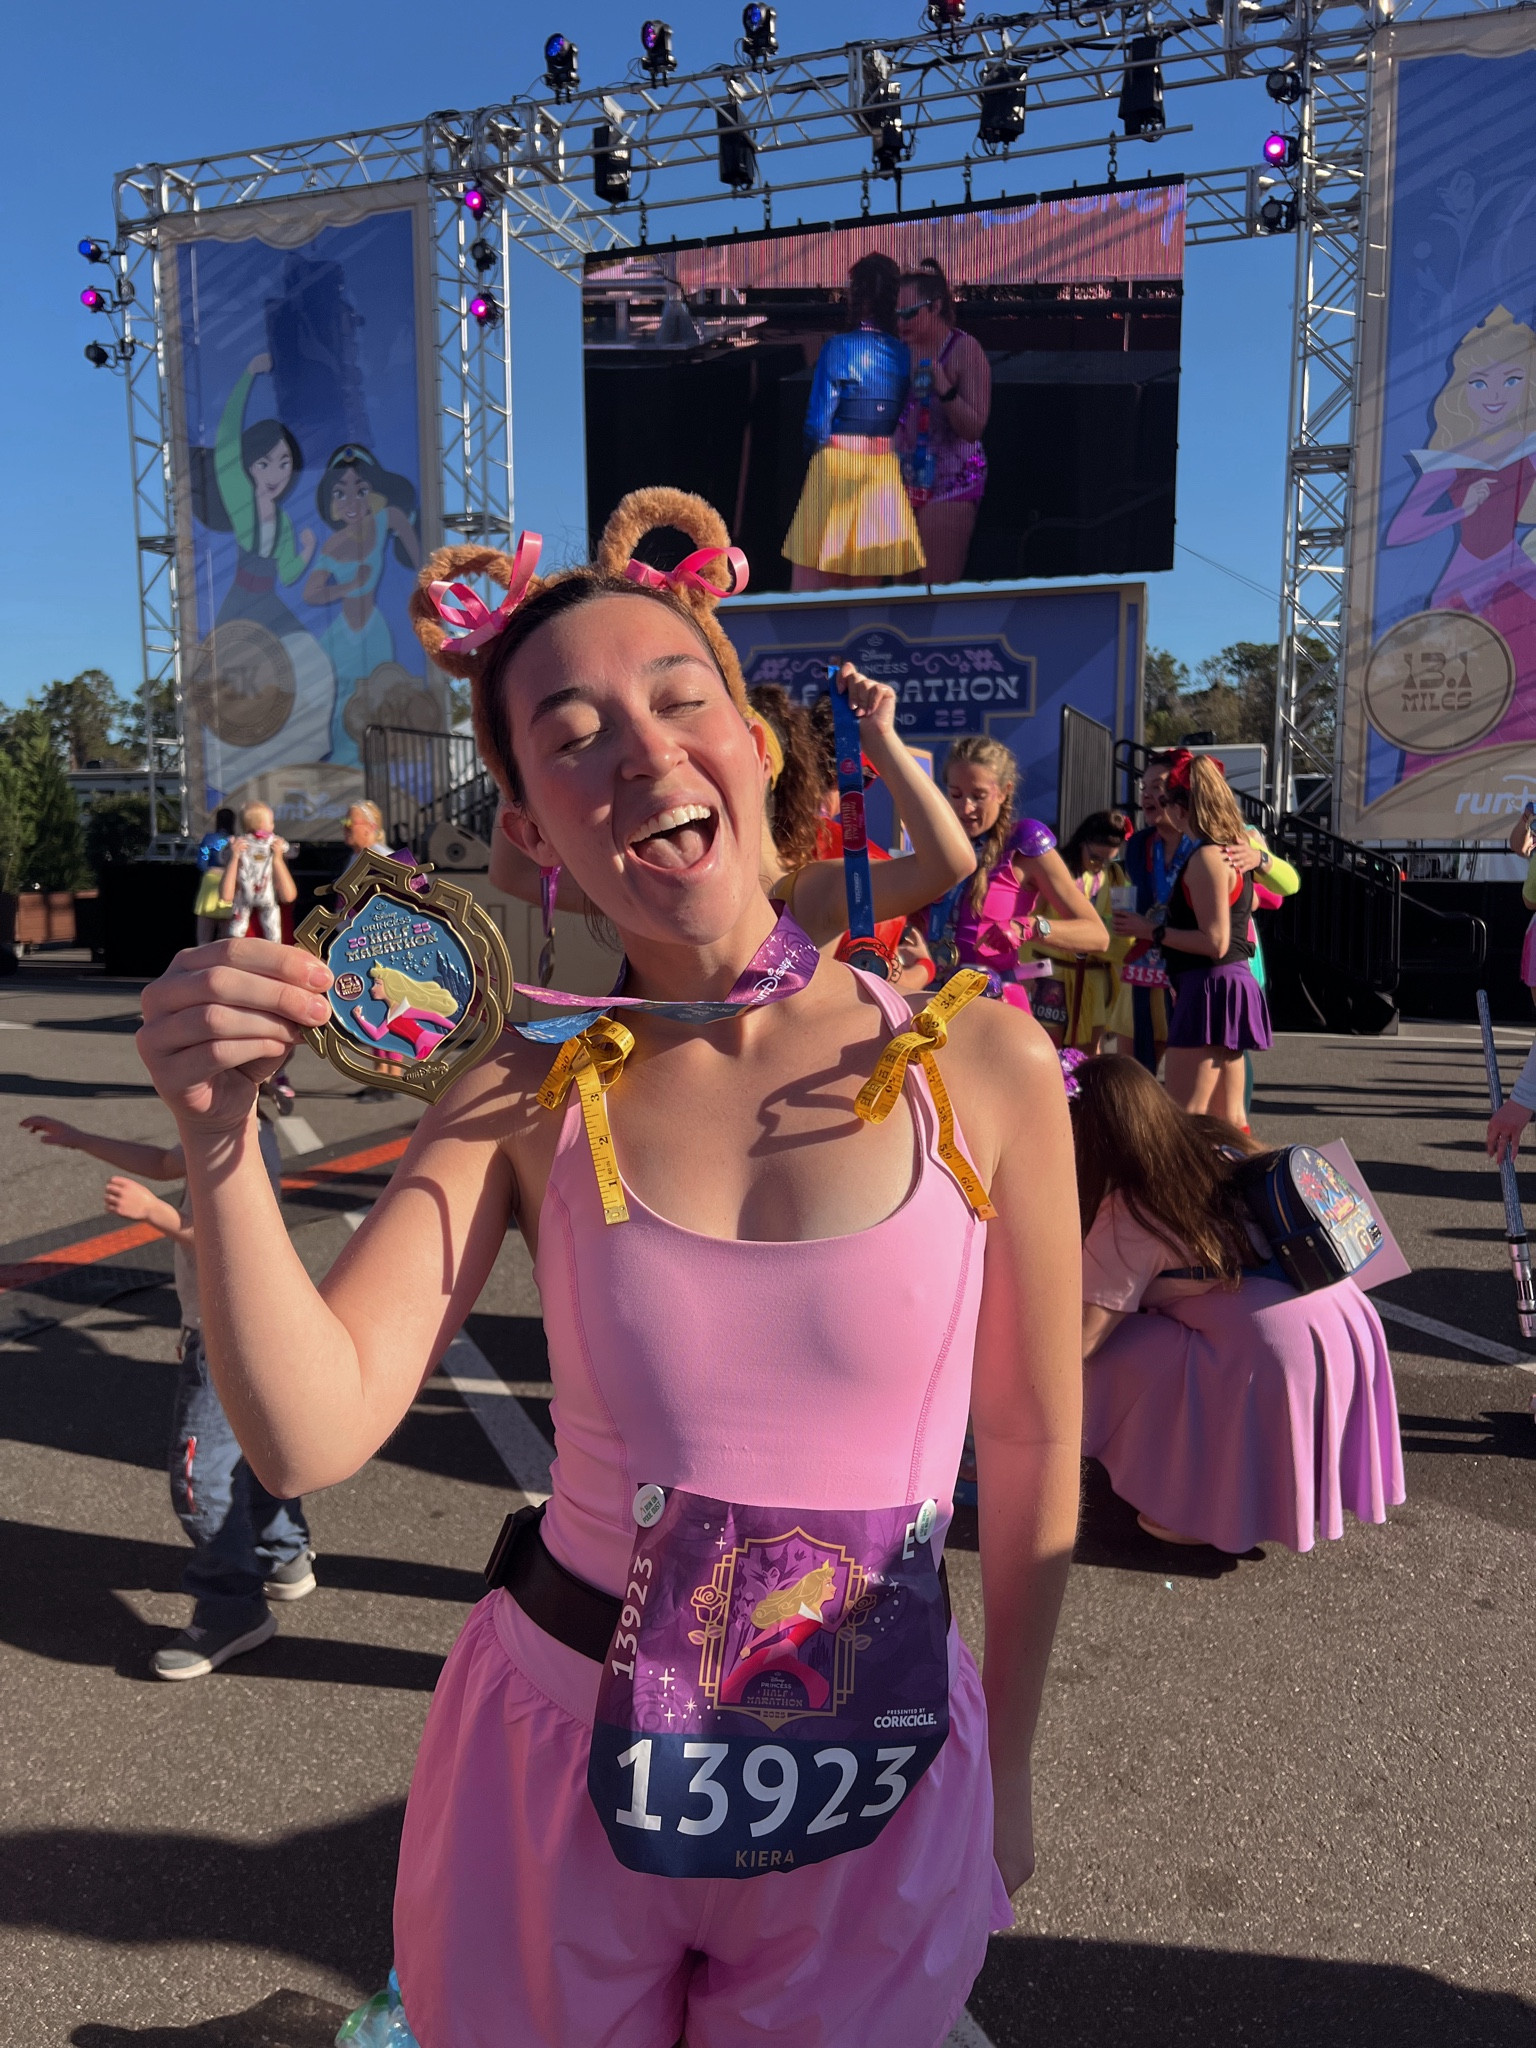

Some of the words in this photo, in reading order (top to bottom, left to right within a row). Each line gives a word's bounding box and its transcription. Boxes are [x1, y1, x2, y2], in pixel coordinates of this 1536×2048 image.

[1402, 651, 1472, 690] 13.1
[1401, 691, 1473, 713] MILES
[935, 708, 967, 727] 25
[361, 915, 411, 934] PRINCESS
[348, 936, 367, 949] 20
[369, 925, 410, 945] HALF
[412, 921, 432, 935] 25
[345, 931, 438, 962] MARATHON
[590, 1093, 601, 1103] 3
[937, 1105, 948, 1124] 58
[598, 1135, 609, 1146] 2
[938, 1142, 953, 1161] 59
[608, 1180, 618, 1188] 1
[960, 1176, 975, 1194] 60
[611, 1555, 653, 1681] 13923
[760, 1681, 792, 1690] PRINCESS
[762, 1688, 789, 1698] HALF
[746, 1696, 803, 1708] MARATHON
[762, 1710, 786, 1719] 2025
[873, 1712, 938, 1729] CORKCICLE.
[614, 1738, 918, 1838] 13923
[734, 1849, 796, 1868] KIERA
